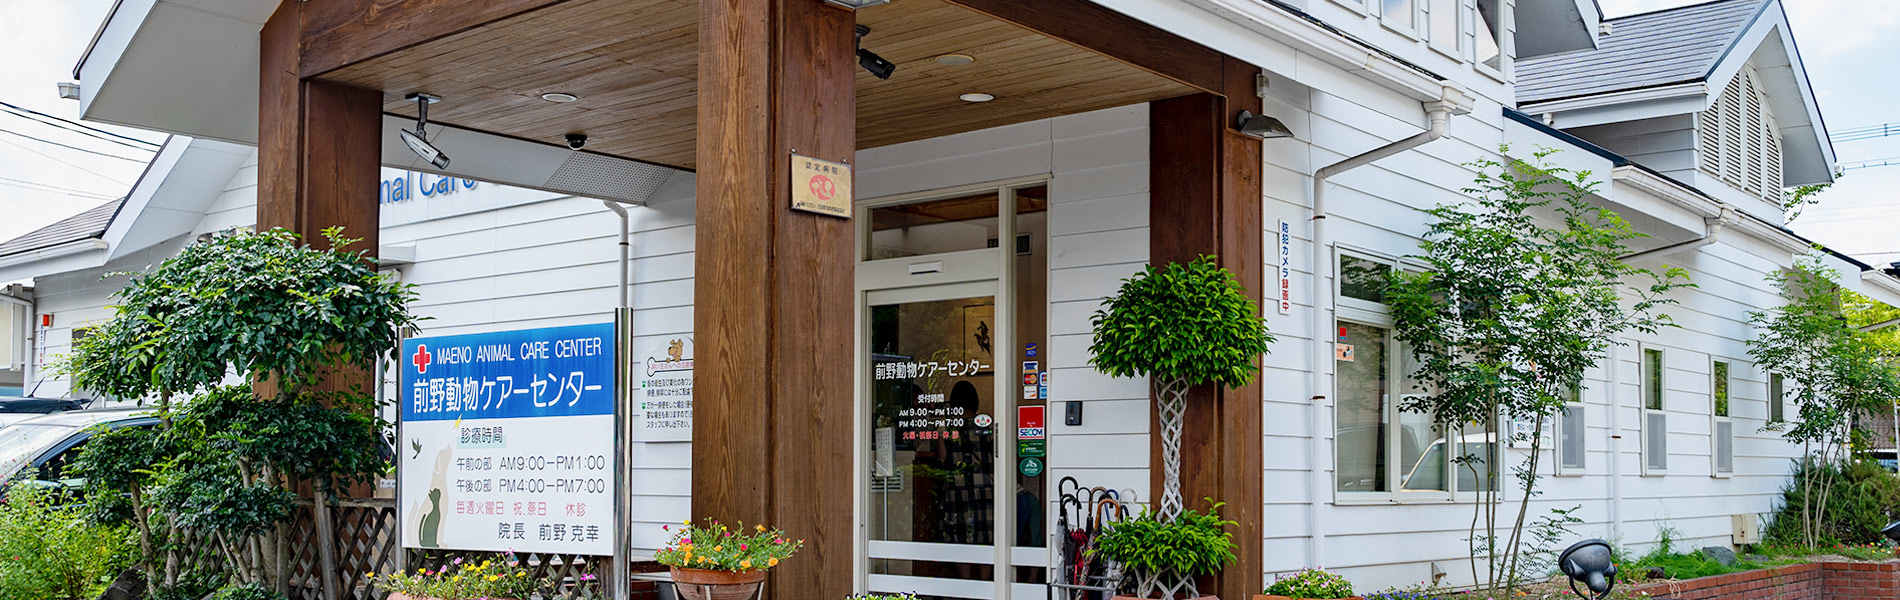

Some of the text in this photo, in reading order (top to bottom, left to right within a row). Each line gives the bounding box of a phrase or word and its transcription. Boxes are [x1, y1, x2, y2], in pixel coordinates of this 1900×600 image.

[437, 337, 602, 365] MAENO ANIMAL CARE CENTER
[875, 359, 990, 380] 前野動物ケアーセンター
[413, 371, 602, 414] 前野動物ケアーセンター
[917, 393, 945, 404] 受付時間
[460, 426, 503, 444] 診療時間
[1020, 428, 1043, 437] SECOM
[456, 456, 492, 471] 午前の部
[456, 479, 492, 493] 午後の部
[456, 500, 504, 515] 毎週火曜日
[565, 502, 587, 517] 休診
[498, 522, 600, 542] 院長 前野 克幸
